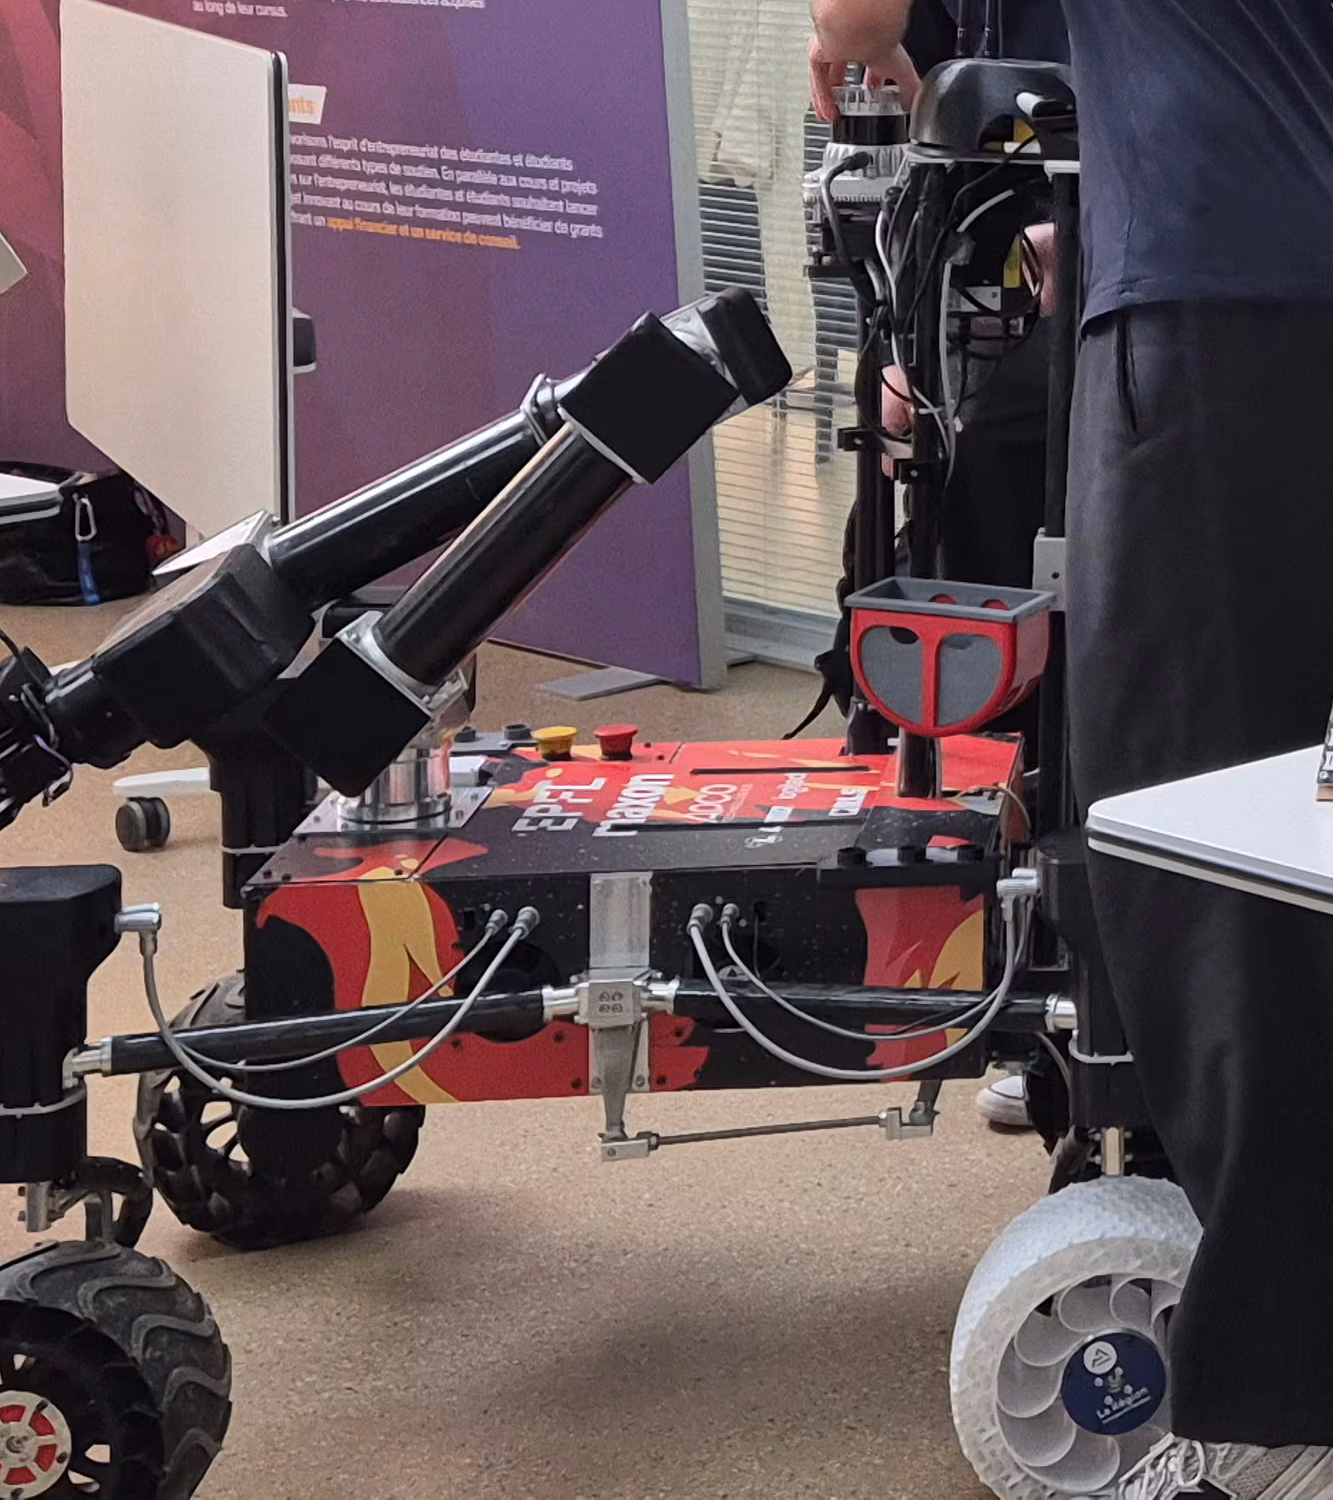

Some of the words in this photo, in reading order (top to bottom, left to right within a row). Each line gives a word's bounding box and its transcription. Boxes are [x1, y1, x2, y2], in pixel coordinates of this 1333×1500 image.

[288, 97, 314, 115] nts
[511, 777, 607, 832] EPFL
[592, 774, 675, 837] maxon
